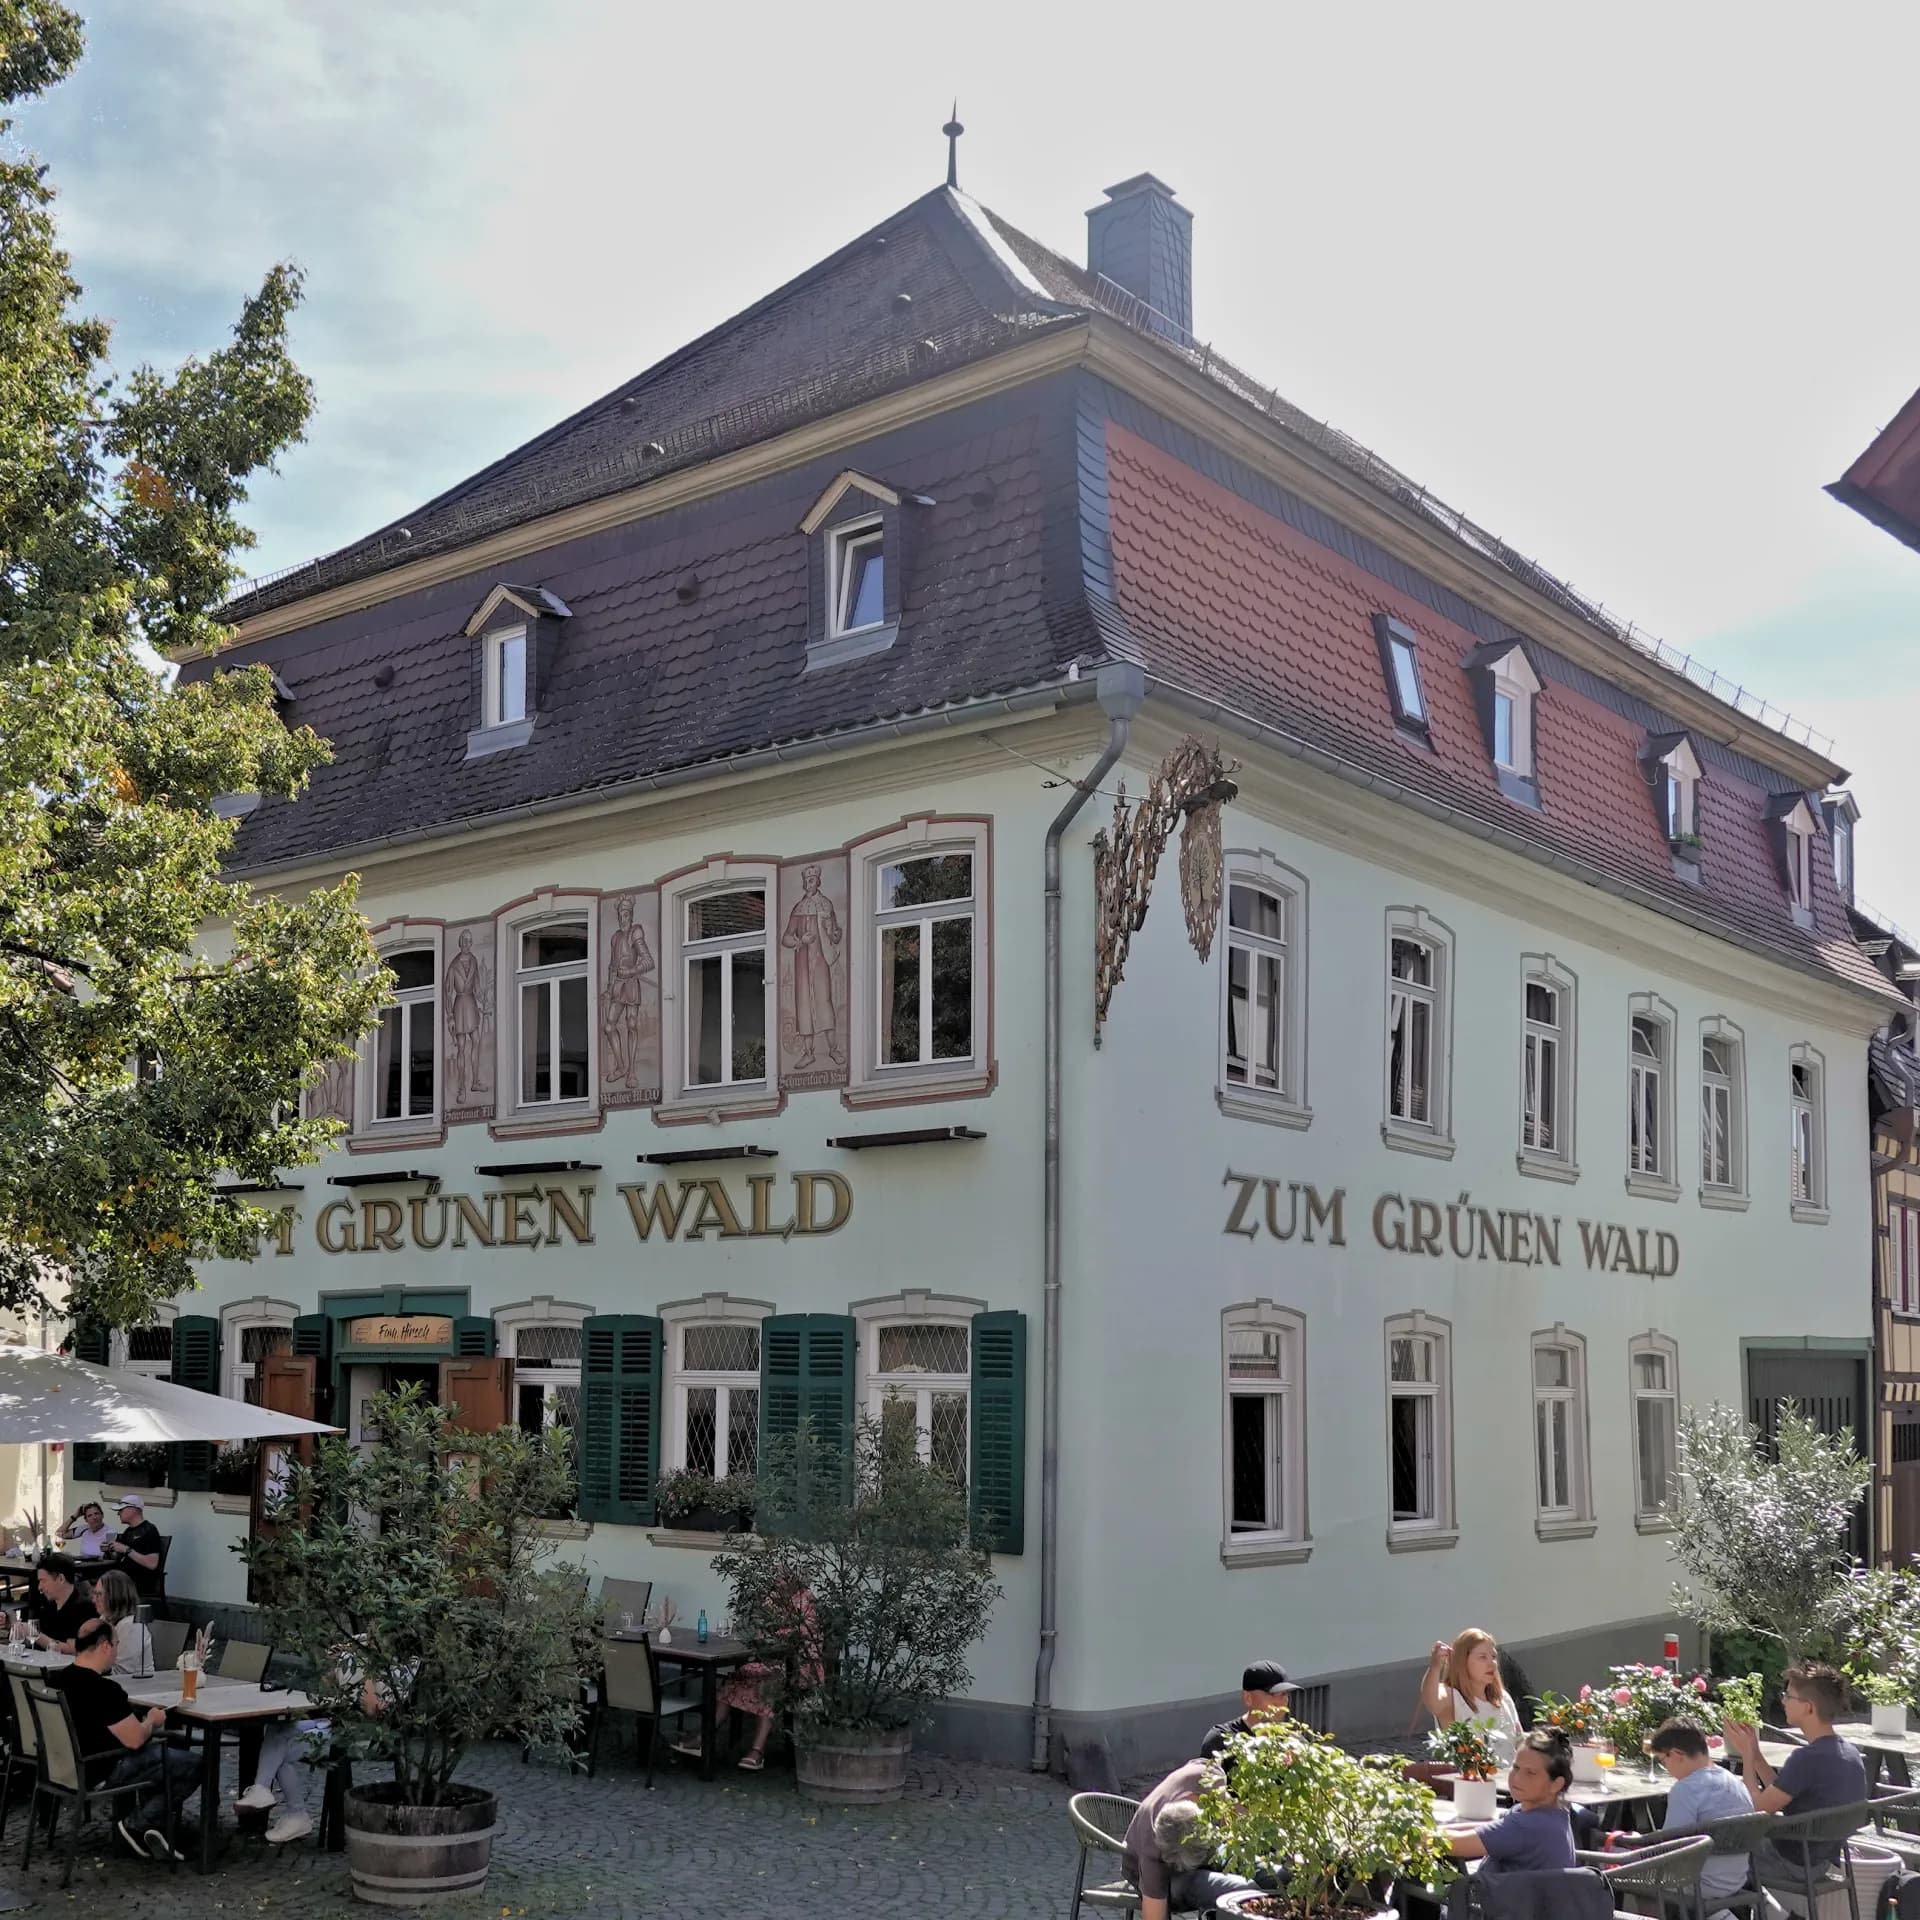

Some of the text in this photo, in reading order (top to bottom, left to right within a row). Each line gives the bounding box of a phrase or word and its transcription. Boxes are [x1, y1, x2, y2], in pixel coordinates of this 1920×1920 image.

[315, 1179, 598, 1254] GRÜNEN
[616, 1171, 855, 1246] WALD
[1221, 1165, 1680, 1282] ZUM GRÜNEN WALD
